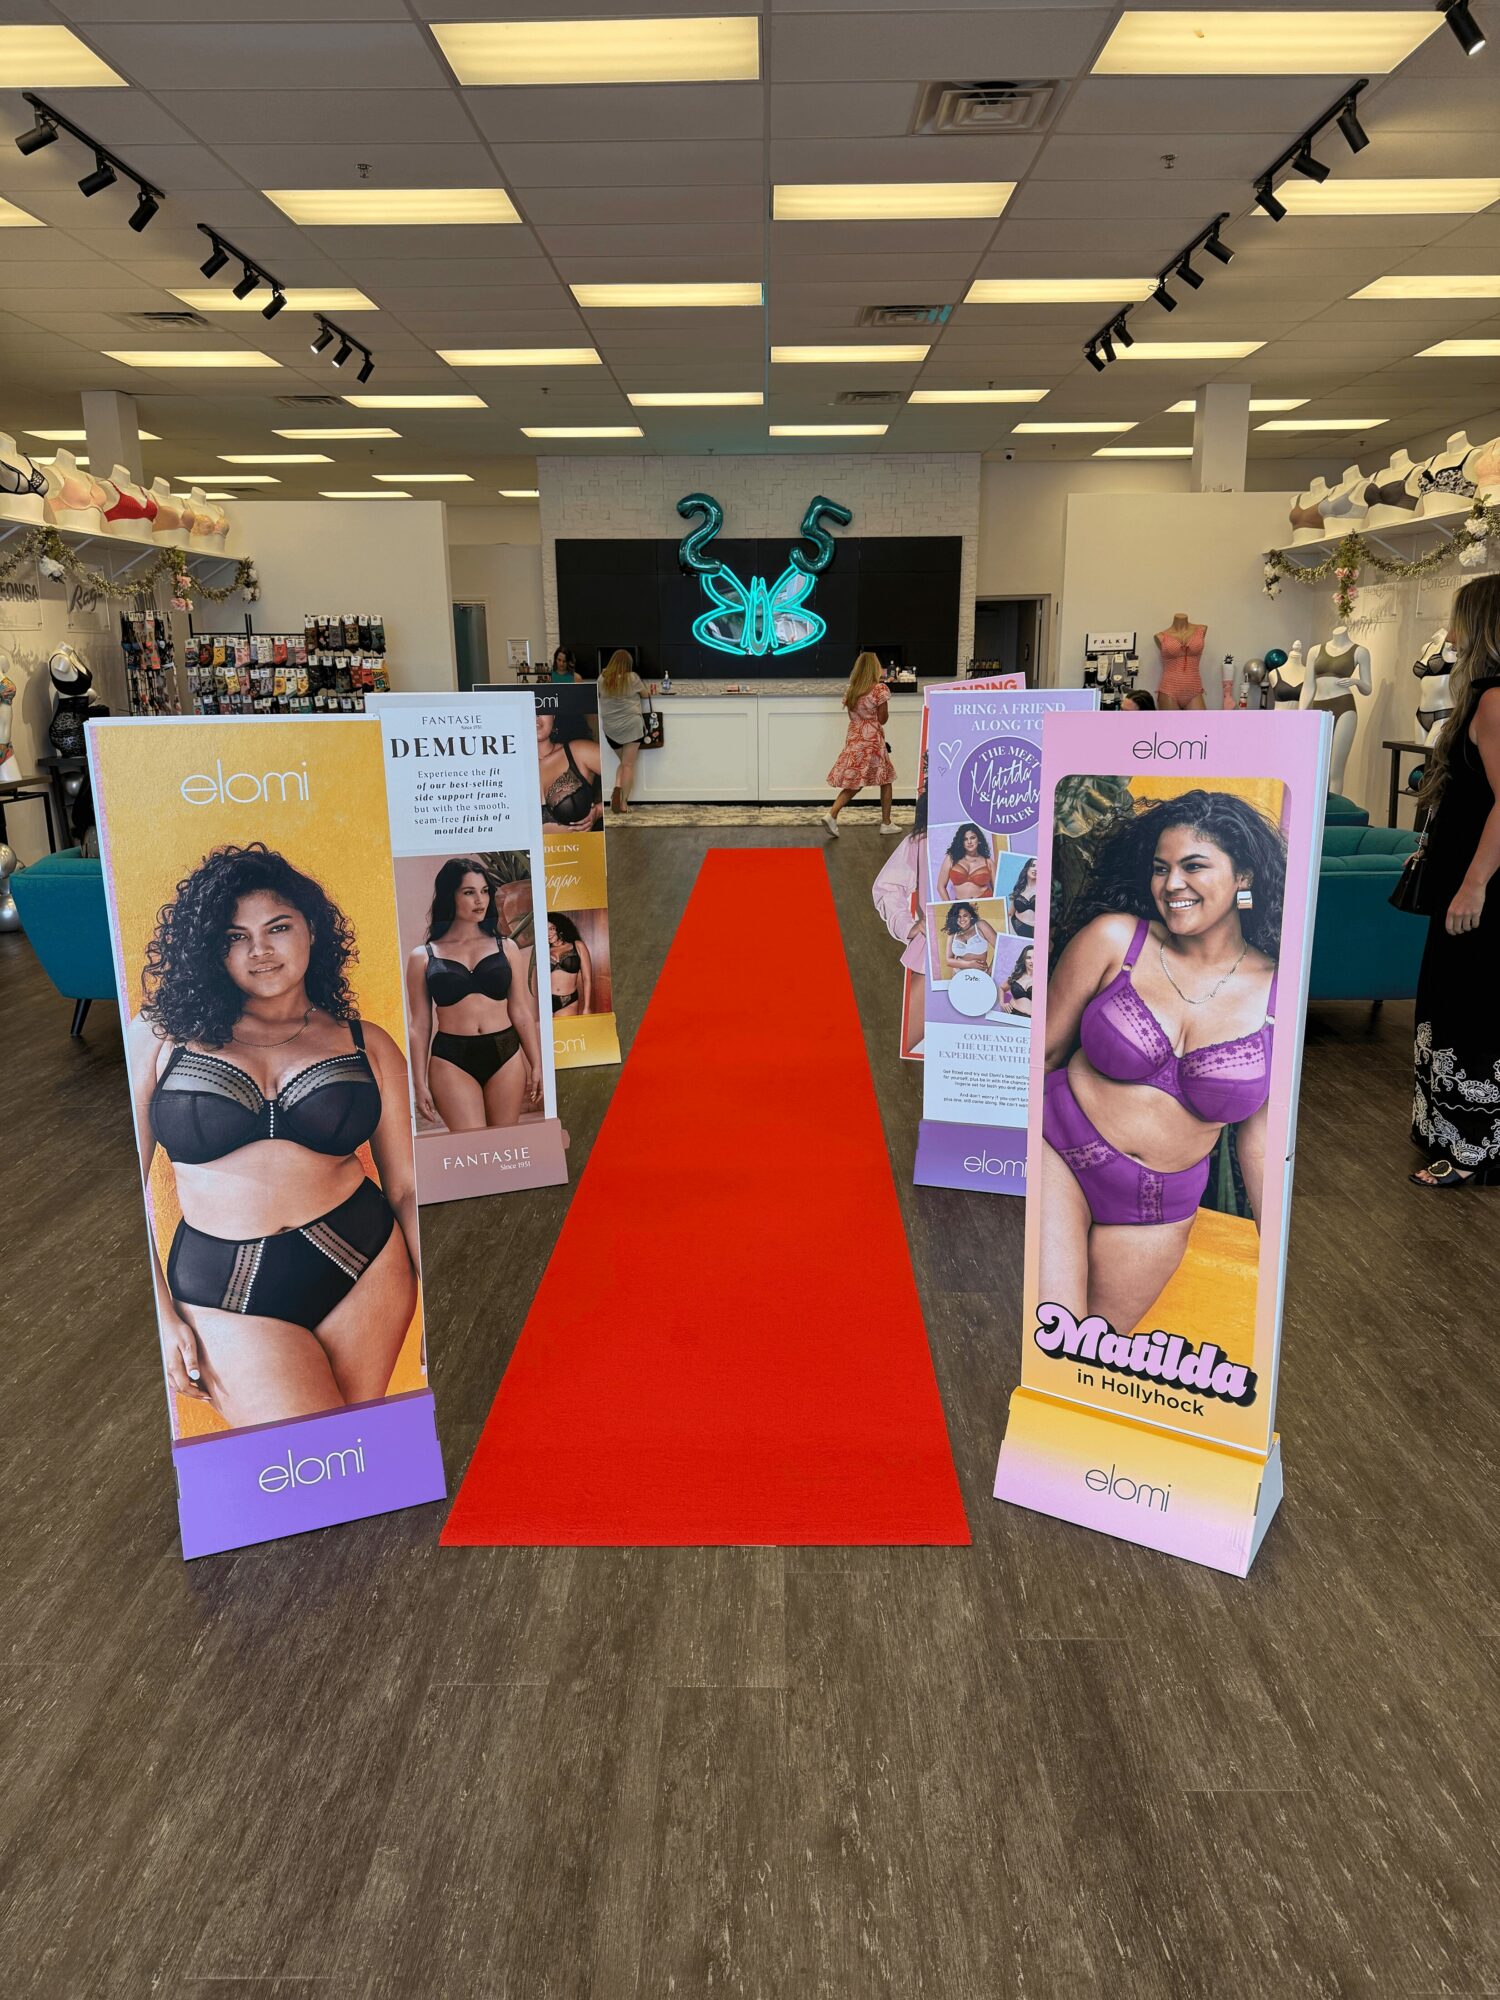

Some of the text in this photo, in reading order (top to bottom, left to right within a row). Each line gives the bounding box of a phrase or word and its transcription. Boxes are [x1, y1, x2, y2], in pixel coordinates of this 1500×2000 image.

[0, 581, 39, 602] EONISA
[534, 693, 559, 708] omi
[953, 702, 1066, 715] BRING A FRIEND
[422, 714, 483, 725] FANTASIE
[971, 719, 1021, 731] ALONG
[390, 734, 517, 758] DEMURE
[1132, 731, 1209, 761] elomi
[978, 745, 1006, 763] THE
[417, 768, 500, 779] Experience the fit
[180, 758, 310, 805] elomi
[416, 782, 426, 791] of
[449, 780, 504, 789] best-selling
[970, 759, 1032, 807] Matilda
[414, 793, 434, 802] side
[437, 792, 474, 802] support
[979, 791, 991, 803] &
[414, 805, 430, 813] but
[432, 804, 453, 813] with
[456, 803, 471, 812] the
[994, 806, 1036, 824] MIXER
[414, 815, 460, 825] seam-free
[462, 814, 490, 824] finish
[492, 813, 502, 822] of
[434, 825, 494, 835] moulded bra
[544, 844, 580, 853] DUCING
[964, 974, 981, 982] Date:
[553, 1033, 587, 1054] omi
[963, 1032, 1031, 1044] COME AND GE
[955, 1041, 975, 1050] THE
[976, 1043, 1027, 1054] ULTIMATE
[938, 1050, 997, 1062] EXPERIENCE
[998, 1055, 1027, 1064] WITH
[443, 1146, 531, 1170] FANTASIE
[963, 1149, 1028, 1178] elomi
[500, 1163, 517, 1171] Since
[1034, 1301, 1258, 1408] Matilda
[1076, 1368, 1205, 1417] in Hollyhock
[258, 1437, 366, 1493] elomi
[1084, 1463, 1172, 1513] elomi
